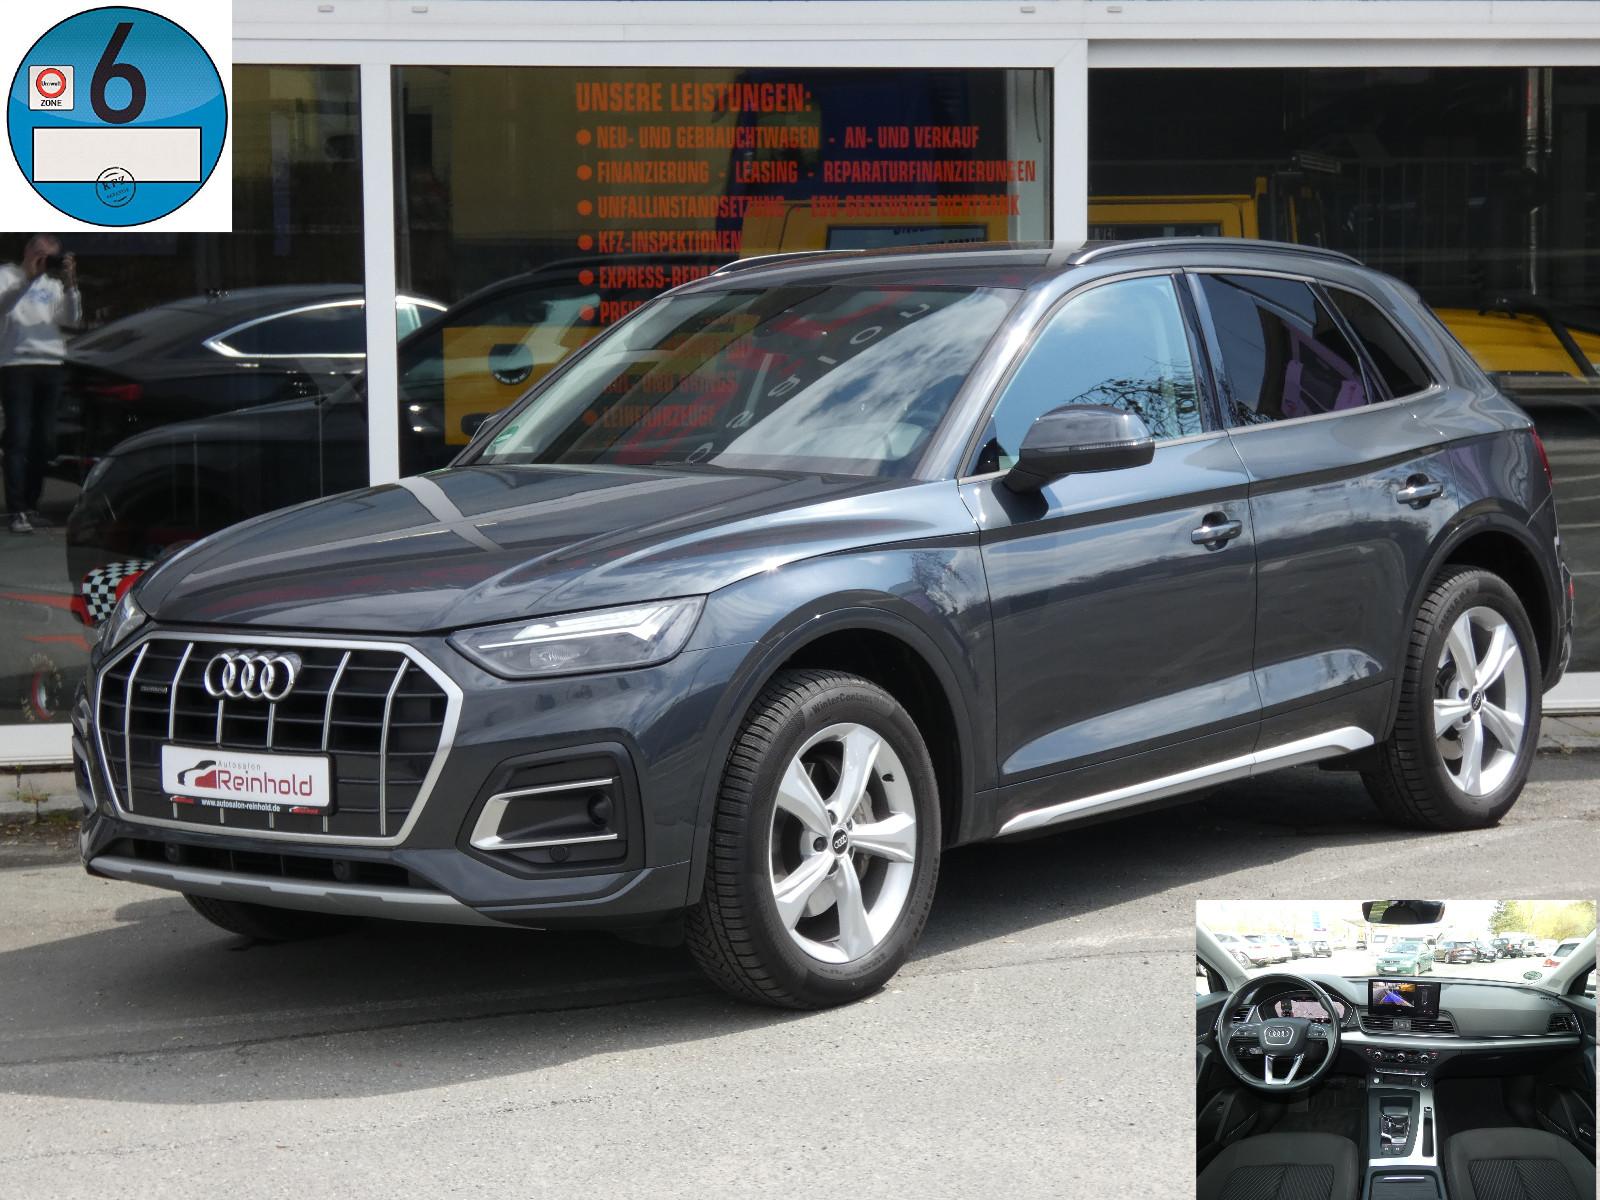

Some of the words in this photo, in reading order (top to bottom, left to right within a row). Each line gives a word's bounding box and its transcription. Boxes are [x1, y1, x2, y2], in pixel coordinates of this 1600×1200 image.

[576, 82, 663, 112] UNSERE
[671, 82, 812, 113] LEISTUNGEN:
[597, 125, 634, 149] NEU-
[639, 125, 671, 149] UND
[676, 125, 819, 149] GEBRAUCHTWAGEN
[844, 125, 873, 149] AN-
[878, 125, 909, 149] UND
[914, 125, 980, 149] VERKAUF
[598, 160, 709, 184] FINANZIERUNG
[735, 160, 798, 184] LEASING
[823, 160, 1036, 183] REPARATURFINANZIERUNGEN
[598, 230, 742, 254] KFZ-INSPEKTIONEN
[217, 760, 261, 771] Autosalon
[217, 770, 313, 796] Reinhold
[201, 798, 281, 812] www.autosalon-reinhold.de
